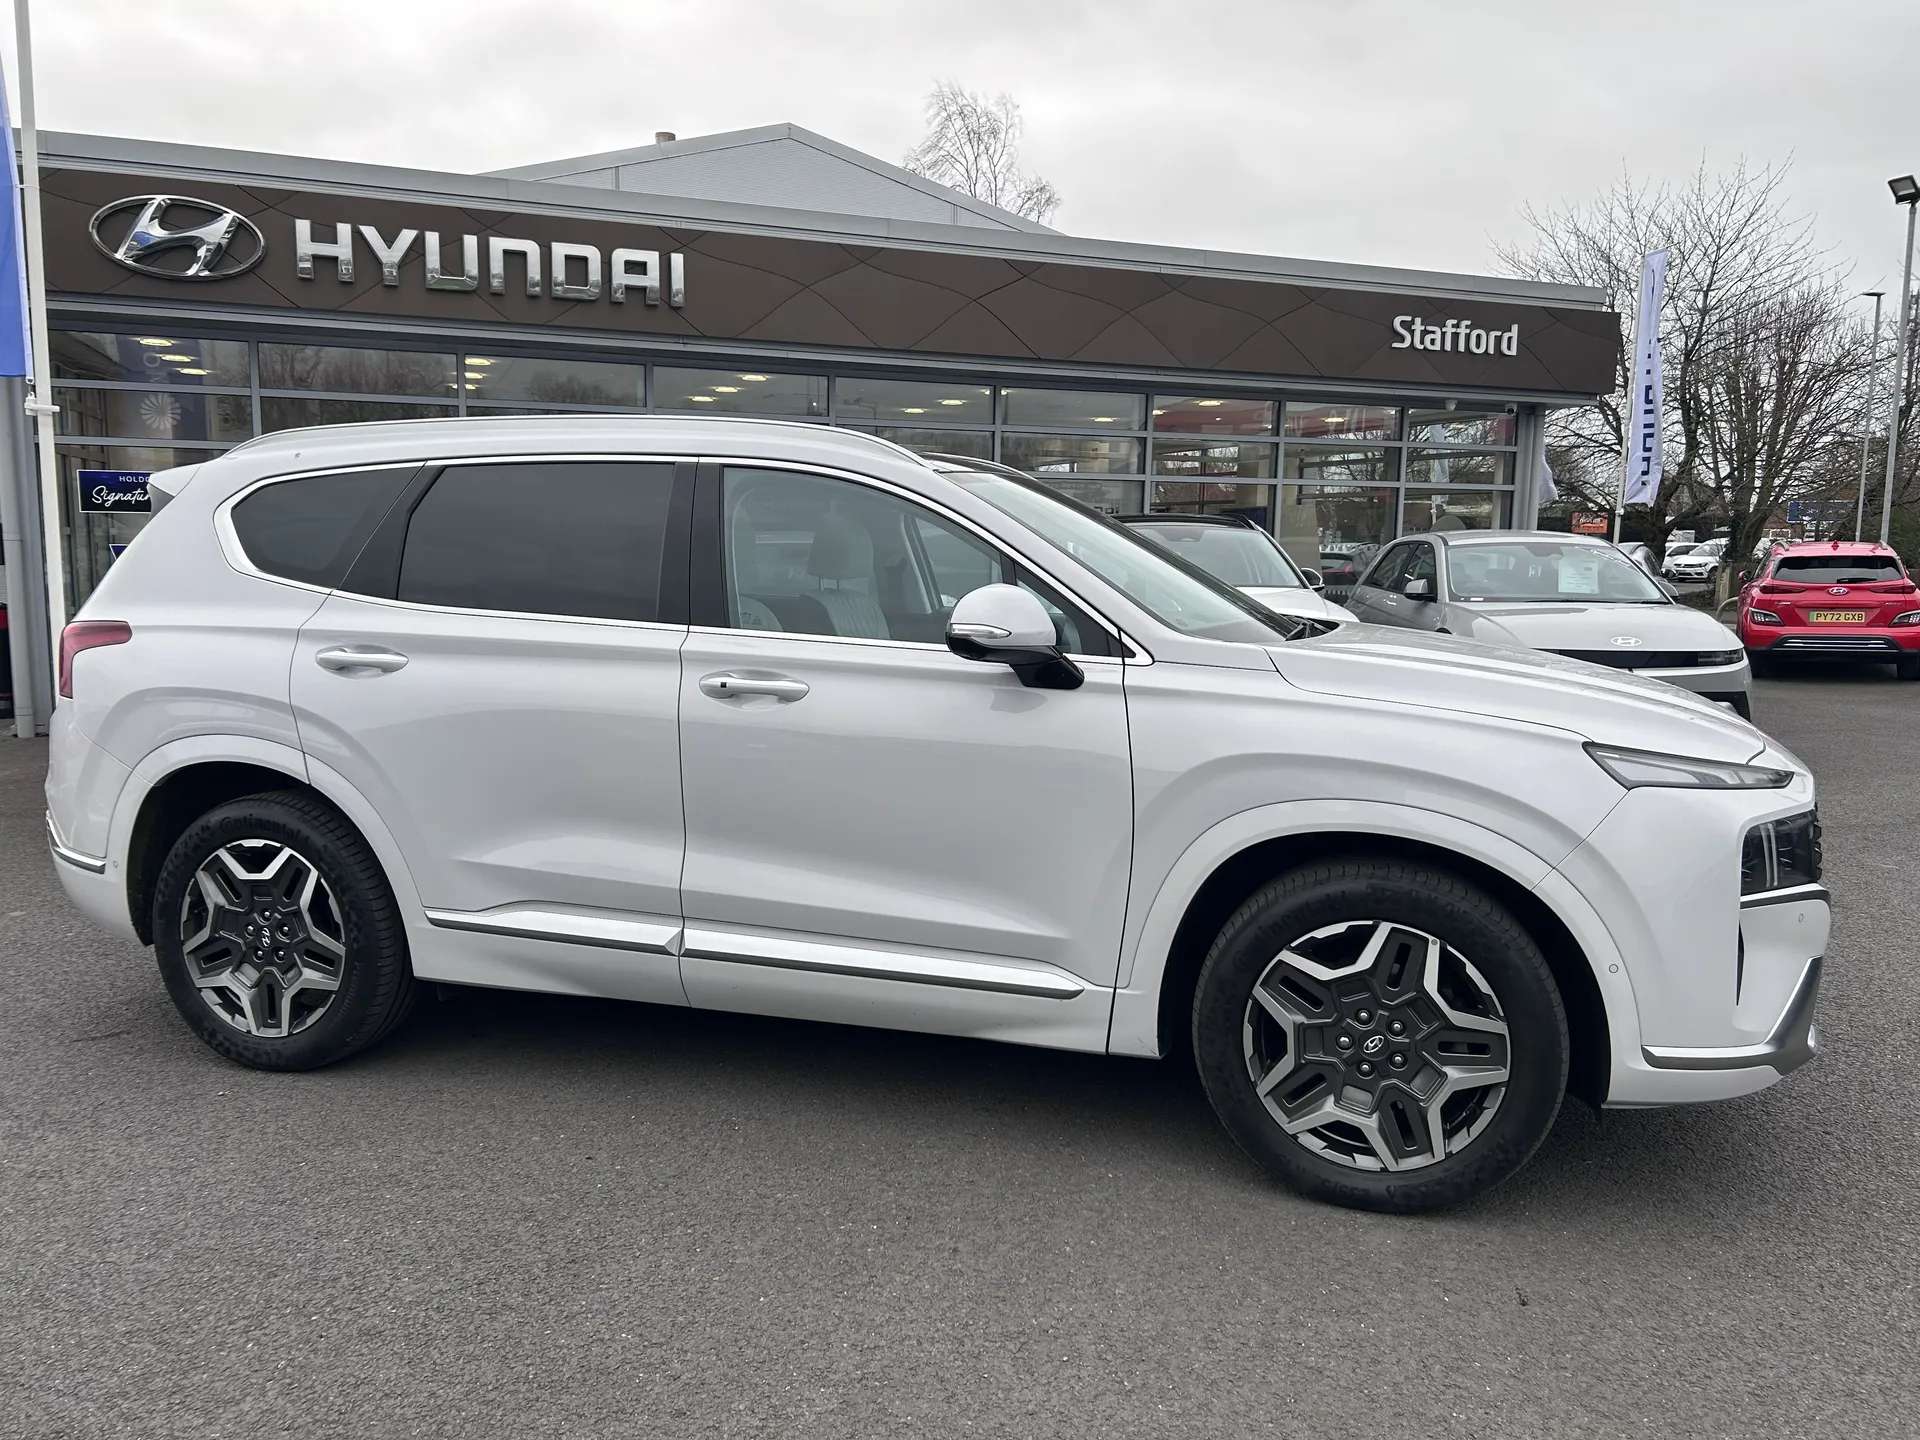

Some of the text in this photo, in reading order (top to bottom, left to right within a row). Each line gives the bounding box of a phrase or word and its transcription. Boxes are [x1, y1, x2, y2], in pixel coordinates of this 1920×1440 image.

[295, 218, 685, 308] HYUNDAI
[1391, 314, 1519, 356] Stafford
[1815, 612, 1864, 622] PY72 GXB
